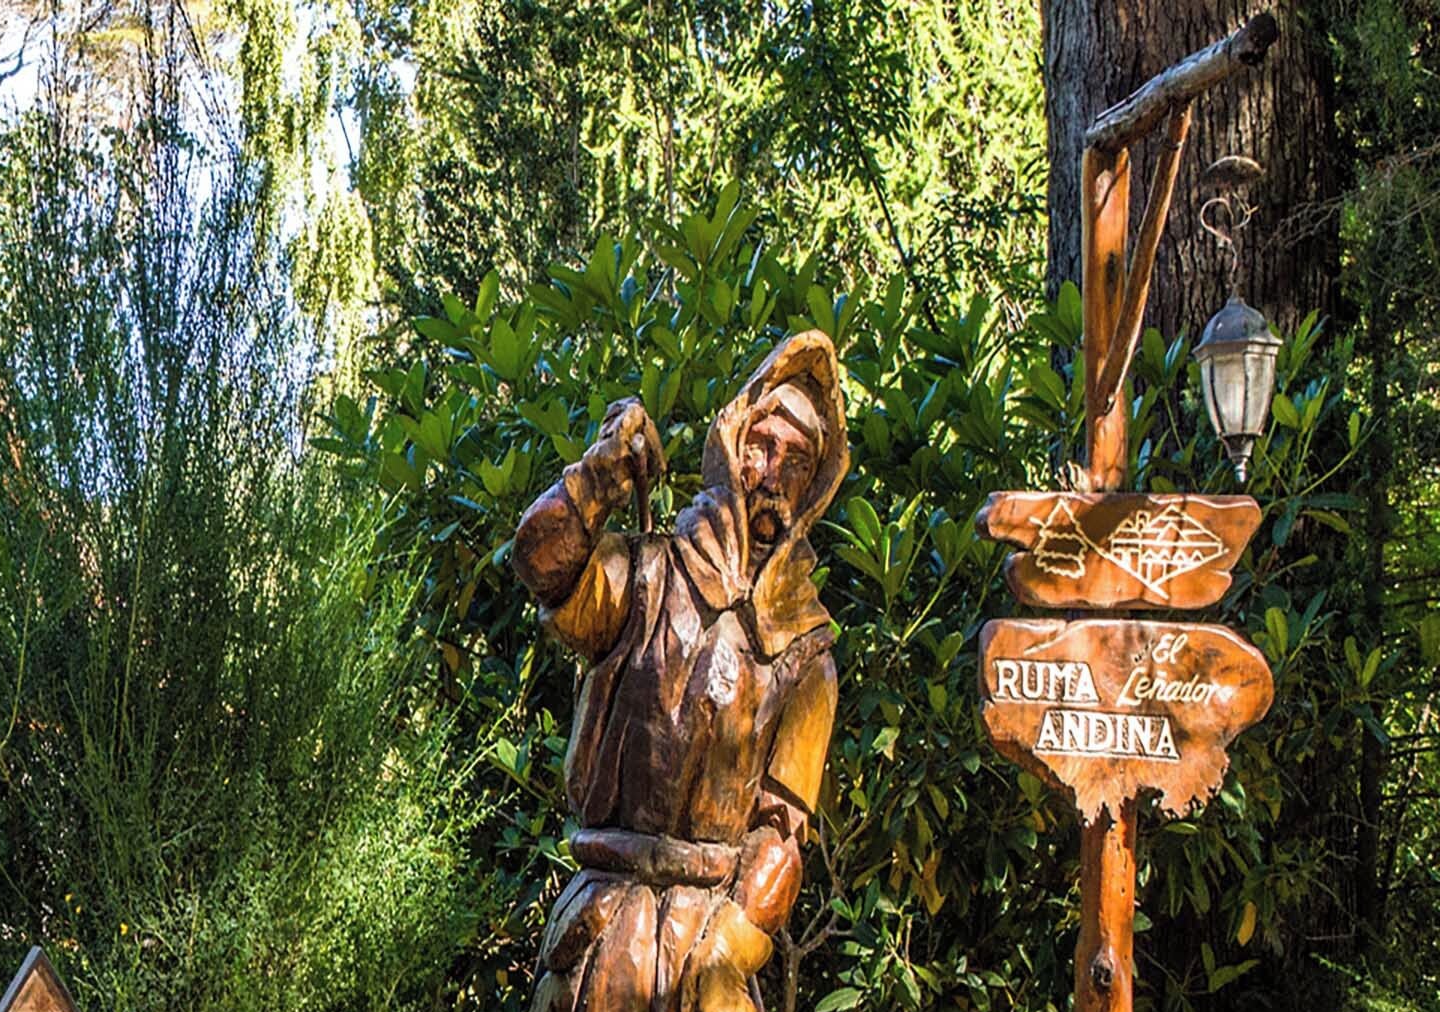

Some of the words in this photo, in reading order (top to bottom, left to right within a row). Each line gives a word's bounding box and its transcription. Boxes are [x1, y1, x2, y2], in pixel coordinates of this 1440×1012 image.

[1151, 633, 1188, 665] El
[992, 660, 1099, 701] RUMA
[1115, 667, 1234, 706] Leñador
[1034, 710, 1179, 758] ANDINA
